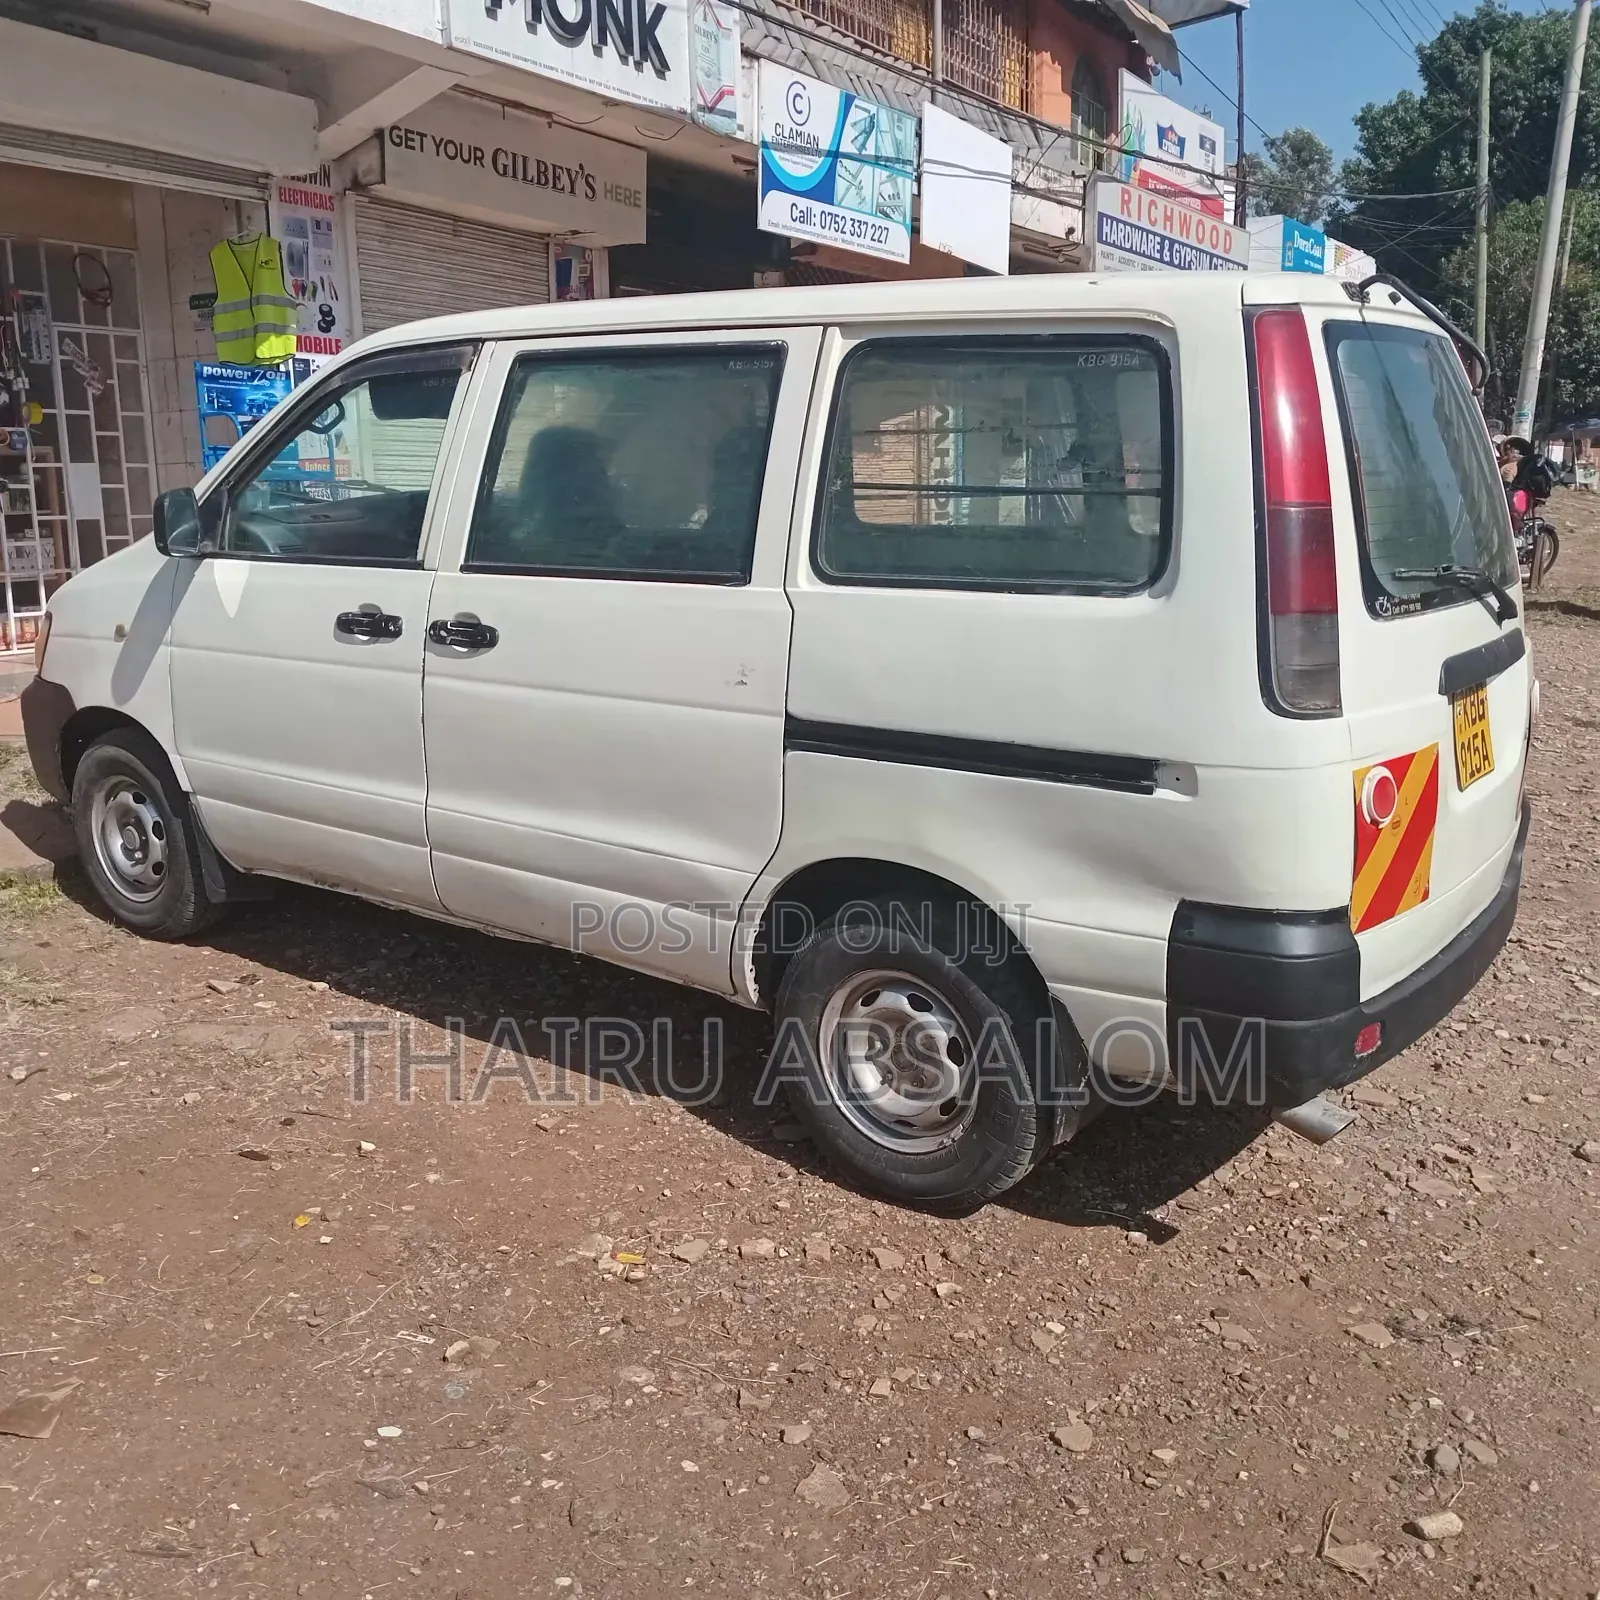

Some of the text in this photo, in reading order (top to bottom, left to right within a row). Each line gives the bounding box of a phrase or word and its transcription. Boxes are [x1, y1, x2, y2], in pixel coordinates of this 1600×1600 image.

[484, 0, 671, 76] ONK
[693, 24, 719, 44] GILBEY'S
[771, 135, 811, 156] ENTERPRISES
[811, 147, 822, 159] LTD
[774, 122, 820, 149] CLAMIAN
[388, 125, 642, 208] GET YOUR GILBEY'S HERE
[278, 185, 335, 212] ELECTRICALS
[790, 202, 889, 245] Call: 0752 337 227
[1120, 186, 1233, 255] RICHWOOD
[1102, 217, 1161, 259] HARDWARE
[1163, 239, 1171, 262] &
[1172, 243, 1210, 271] GYPSUM
[1294, 230, 1322, 259] DuraCoat
[202, 364, 251, 380] power
[1077, 353, 1140, 367] KBG 915A
[1462, 681, 1486, 731] KBG
[1460, 729, 1492, 783] 915A
